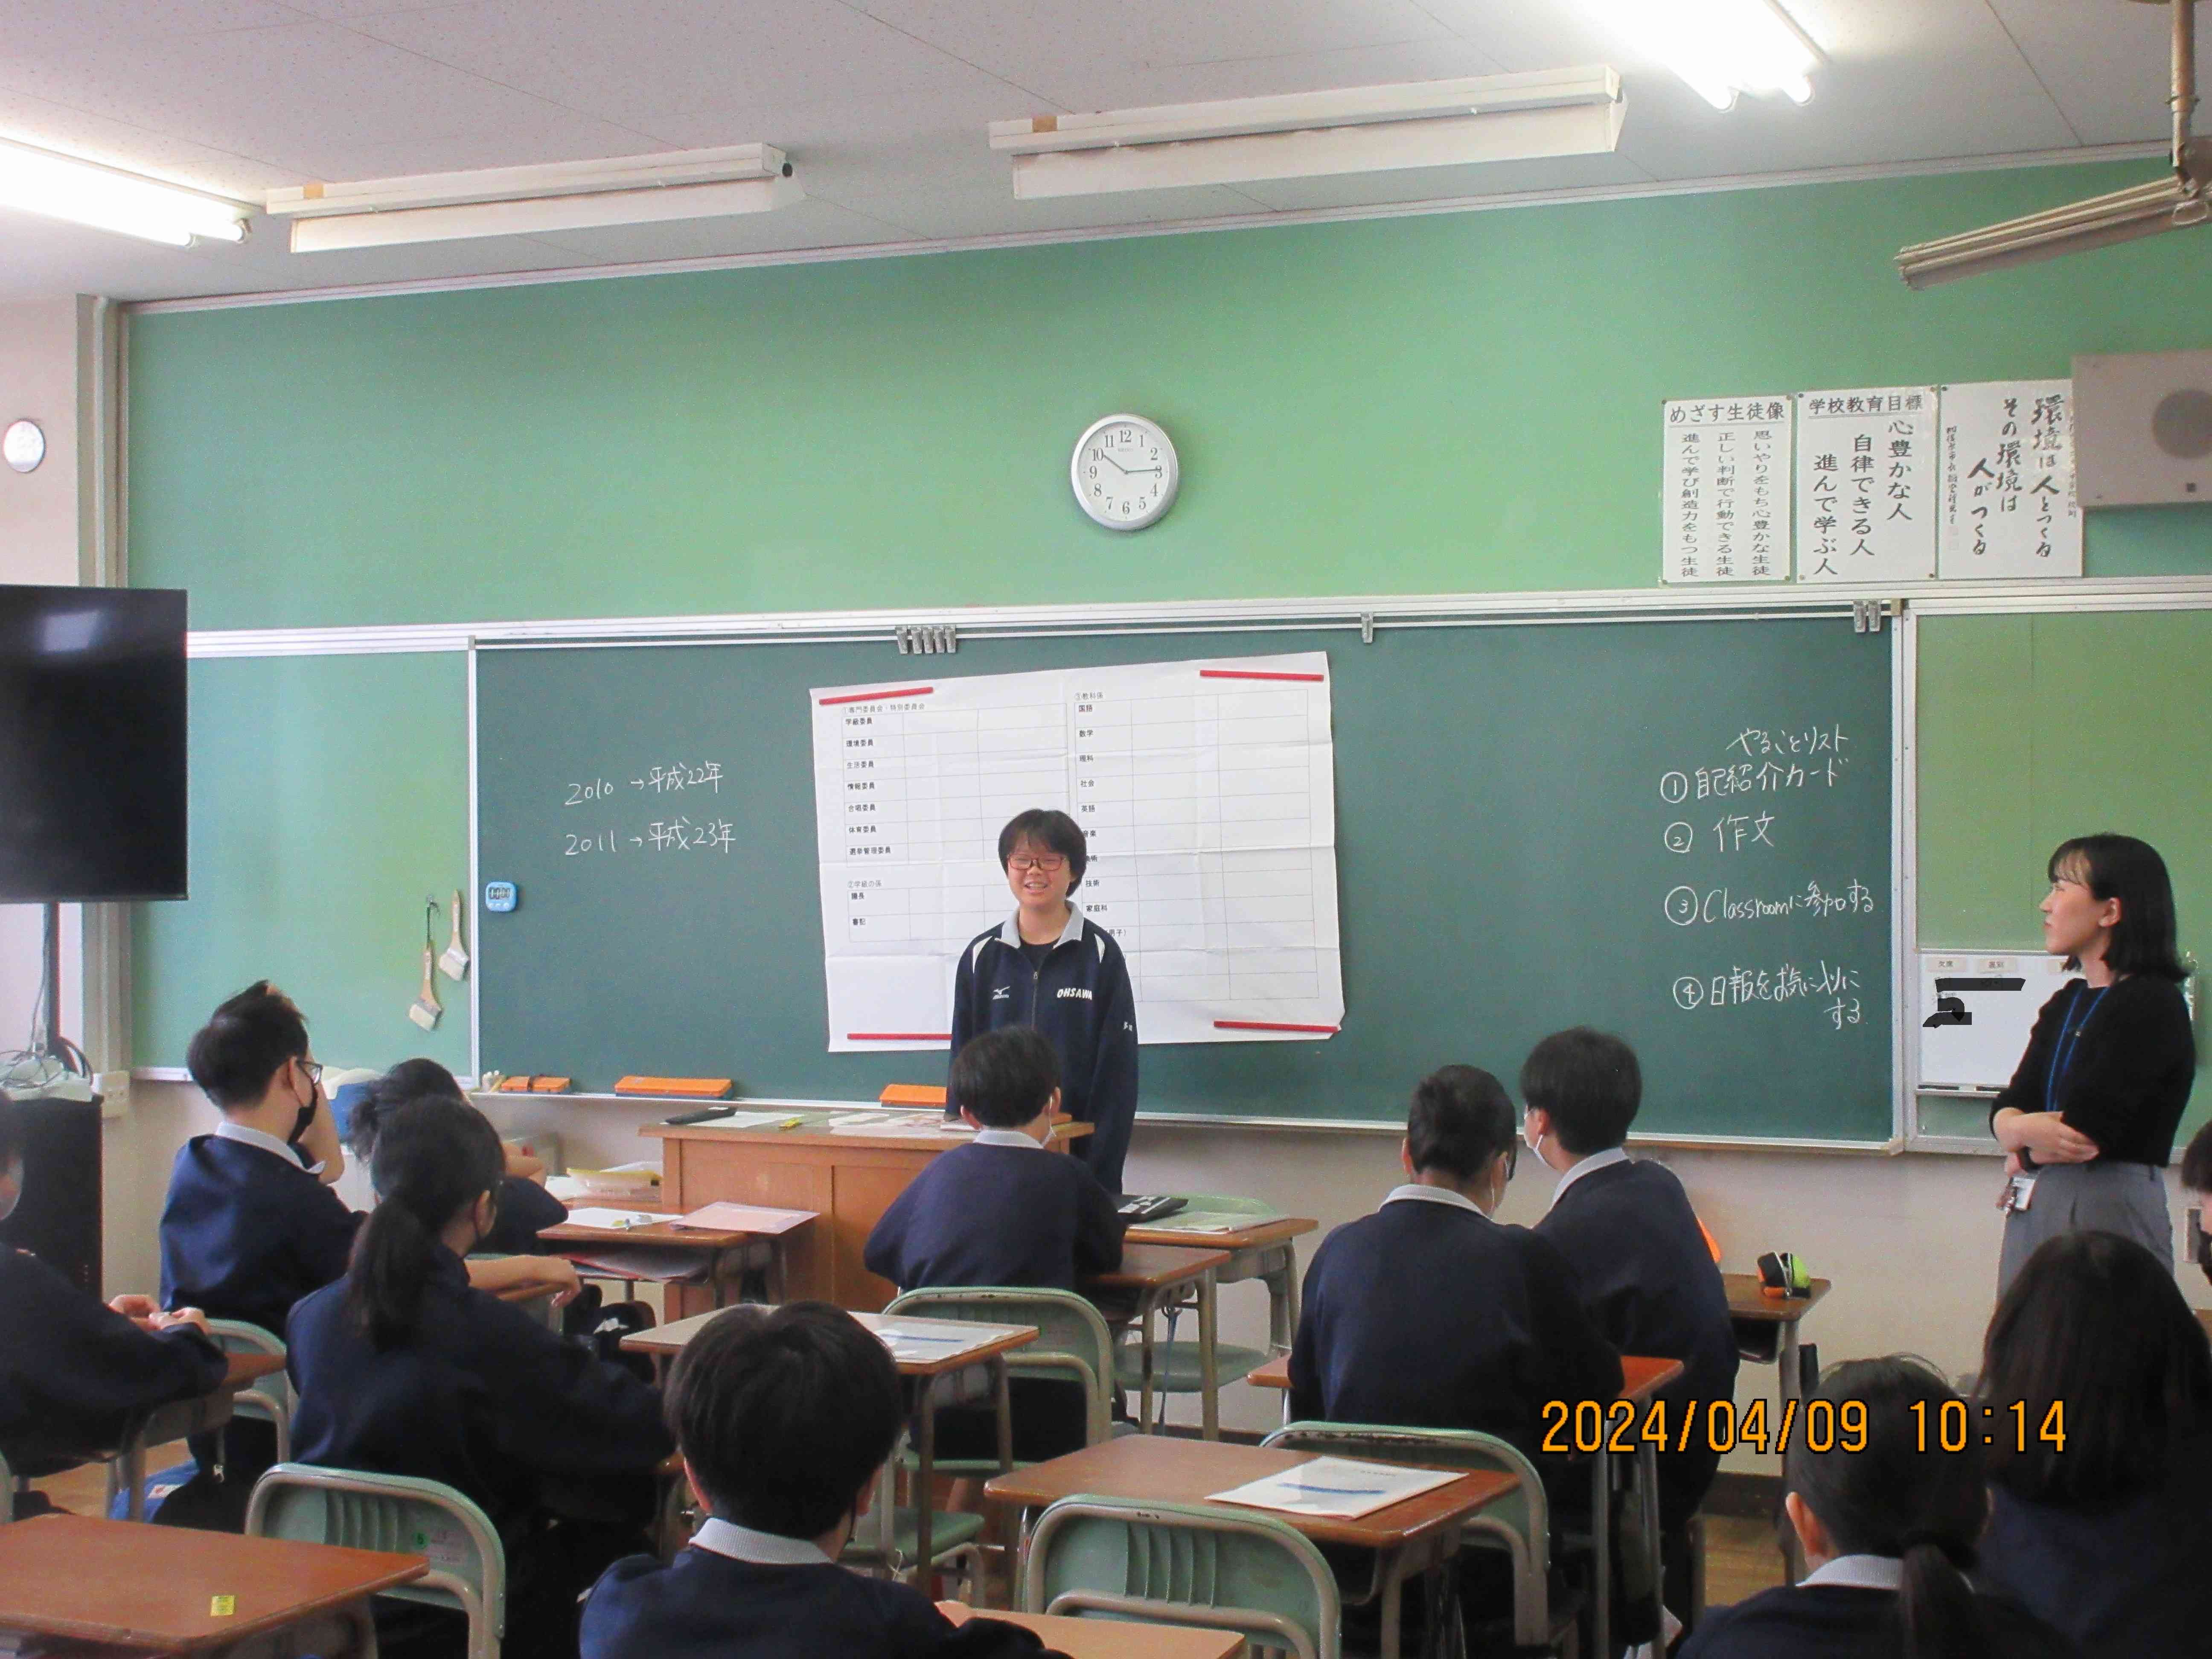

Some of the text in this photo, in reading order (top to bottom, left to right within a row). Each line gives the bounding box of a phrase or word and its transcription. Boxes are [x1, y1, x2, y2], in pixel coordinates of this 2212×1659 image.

[1809, 395, 1923, 414] 学校教育目標
[1670, 403, 1784, 423] めざす生徒像
[1105, 435, 1114, 447] 11
[1119, 430, 1132, 442] 12
[1140, 435, 1144, 447] 1
[1092, 448, 1104, 461] 10
[1150, 448, 1158, 460] 2
[1089, 466, 1097, 479] 9
[1155, 466, 1162, 478] 3
[1887, 420, 1913, 521] 心豊かな人
[1094, 483, 1102, 496] 8
[1150, 484, 1158, 497] 4
[1850, 434, 1875, 556] 自律できる人
[1106, 497, 1113, 509] 7
[1122, 501, 1130, 515] 6
[1139, 497, 1146, 509] 5
[1681, 433, 1700, 577] 進んで学び創造力をもつ生徒
[1717, 431, 1735, 576] 正しい判断で行動できる生徒
[1752, 430, 1772, 576] 思いやりをもち心豊かな生徒
[1813, 454, 1838, 575] 進んで学ぶ人
[1079, 729, 1094, 737] 数学
[846, 739, 873, 748] 環境委員
[1726, 724, 1848, 756] やることリスト
[847, 760, 874, 769] 生活委員
[1079, 754, 1094, 763] 理科
[564, 761, 724, 805] 2010 平成22年
[1080, 780, 1095, 788] 社会
[1080, 804, 1095, 813] 英語
[565, 816, 736, 855] 2011 平成23年
[849, 825, 876, 834] 体育委員
[1713, 811, 1775, 852] 作文
[1086, 904, 1107, 913] 家庭科
[1057, 988, 1092, 1000] OHSAWA
[1823, 997, 1861, 1030] する
